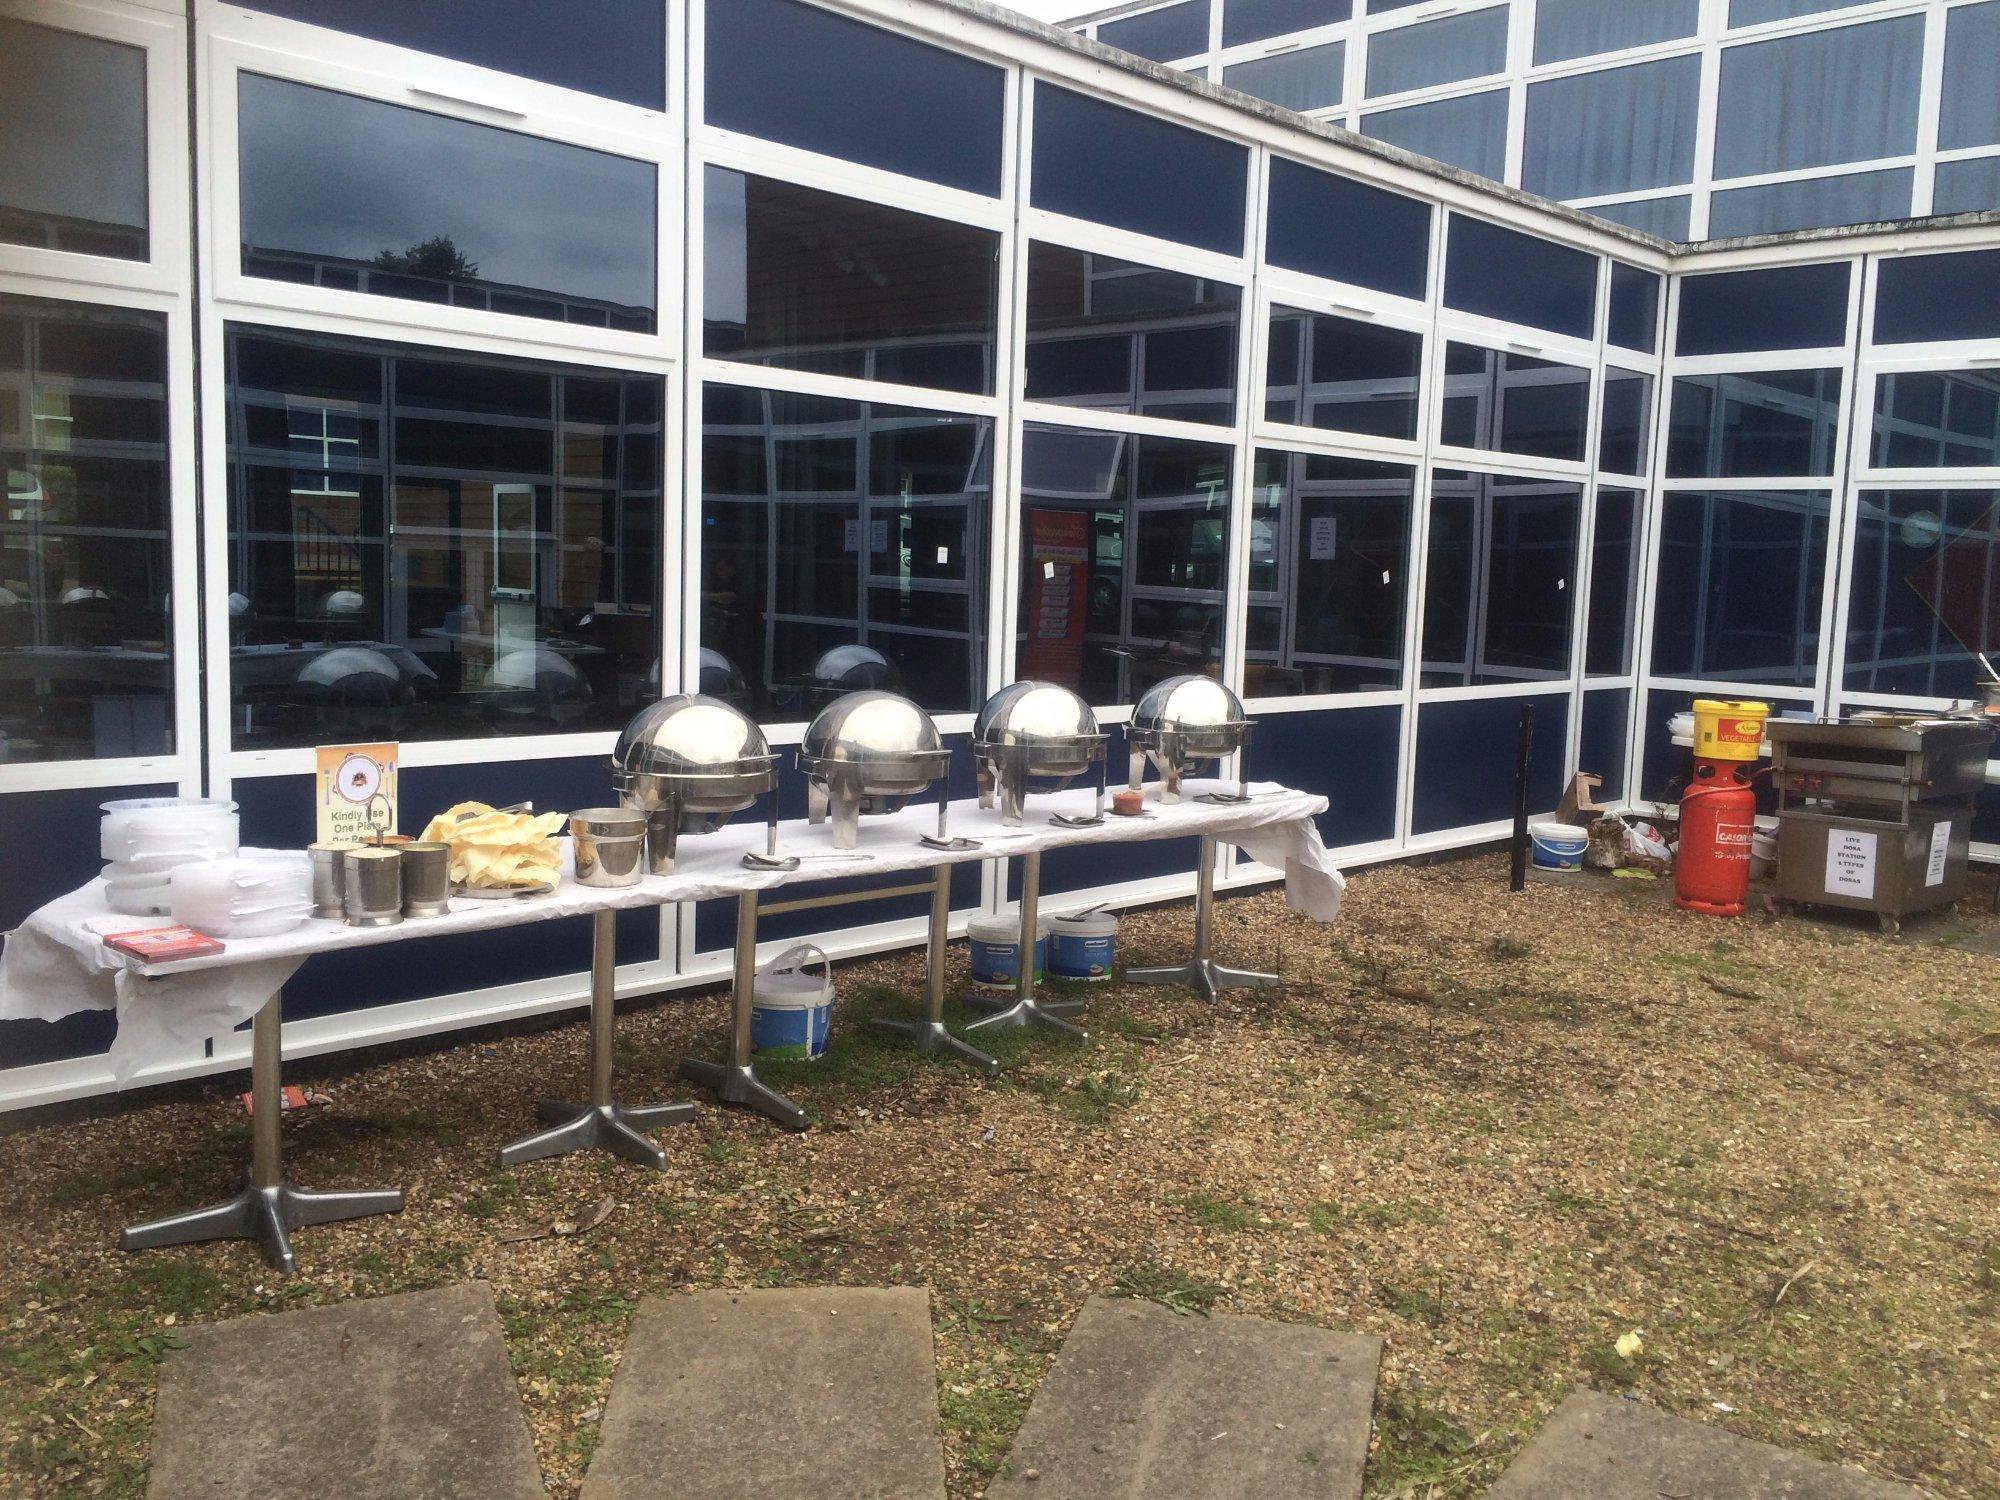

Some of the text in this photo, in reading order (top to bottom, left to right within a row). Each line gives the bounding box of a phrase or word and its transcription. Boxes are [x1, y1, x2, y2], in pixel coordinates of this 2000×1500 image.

[331, 810, 363, 822] Kindly
[334, 824, 354, 834] One
[1837, 852, 1867, 860] STATION
